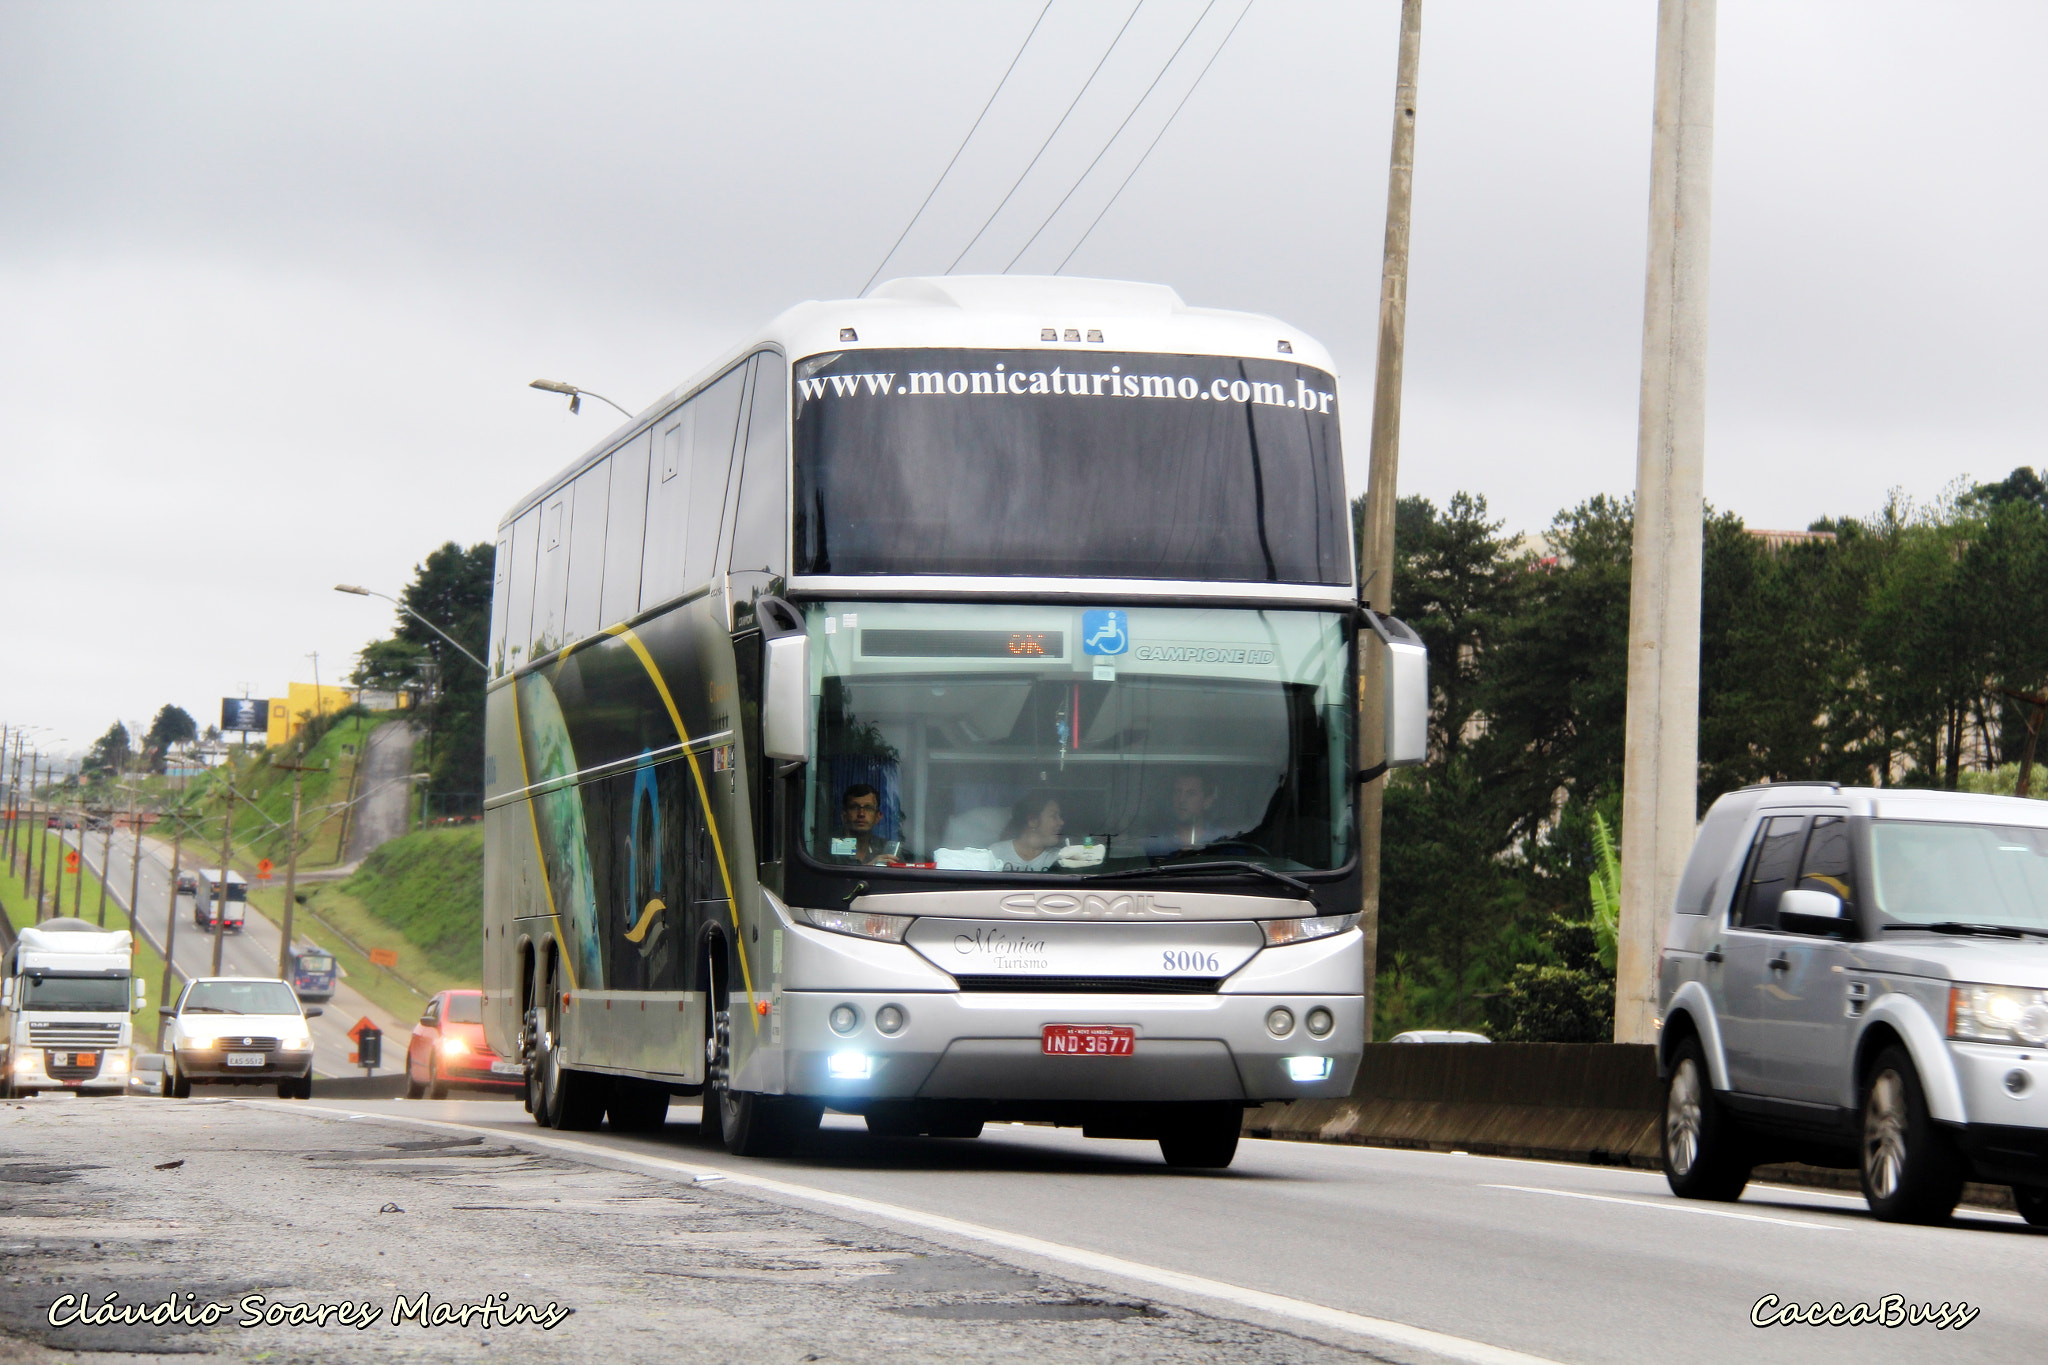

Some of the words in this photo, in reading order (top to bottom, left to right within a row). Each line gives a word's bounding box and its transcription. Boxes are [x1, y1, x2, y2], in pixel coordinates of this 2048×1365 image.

[798, 363, 1334, 415] www.monicaturismo.com.br
[1135, 645, 1245, 663] CAMPIONE
[1248, 649, 1275, 664] HD
[1000, 893, 1182, 916] COMIL
[993, 956, 1049, 969] Turismo
[1163, 950, 1220, 972] 8006
